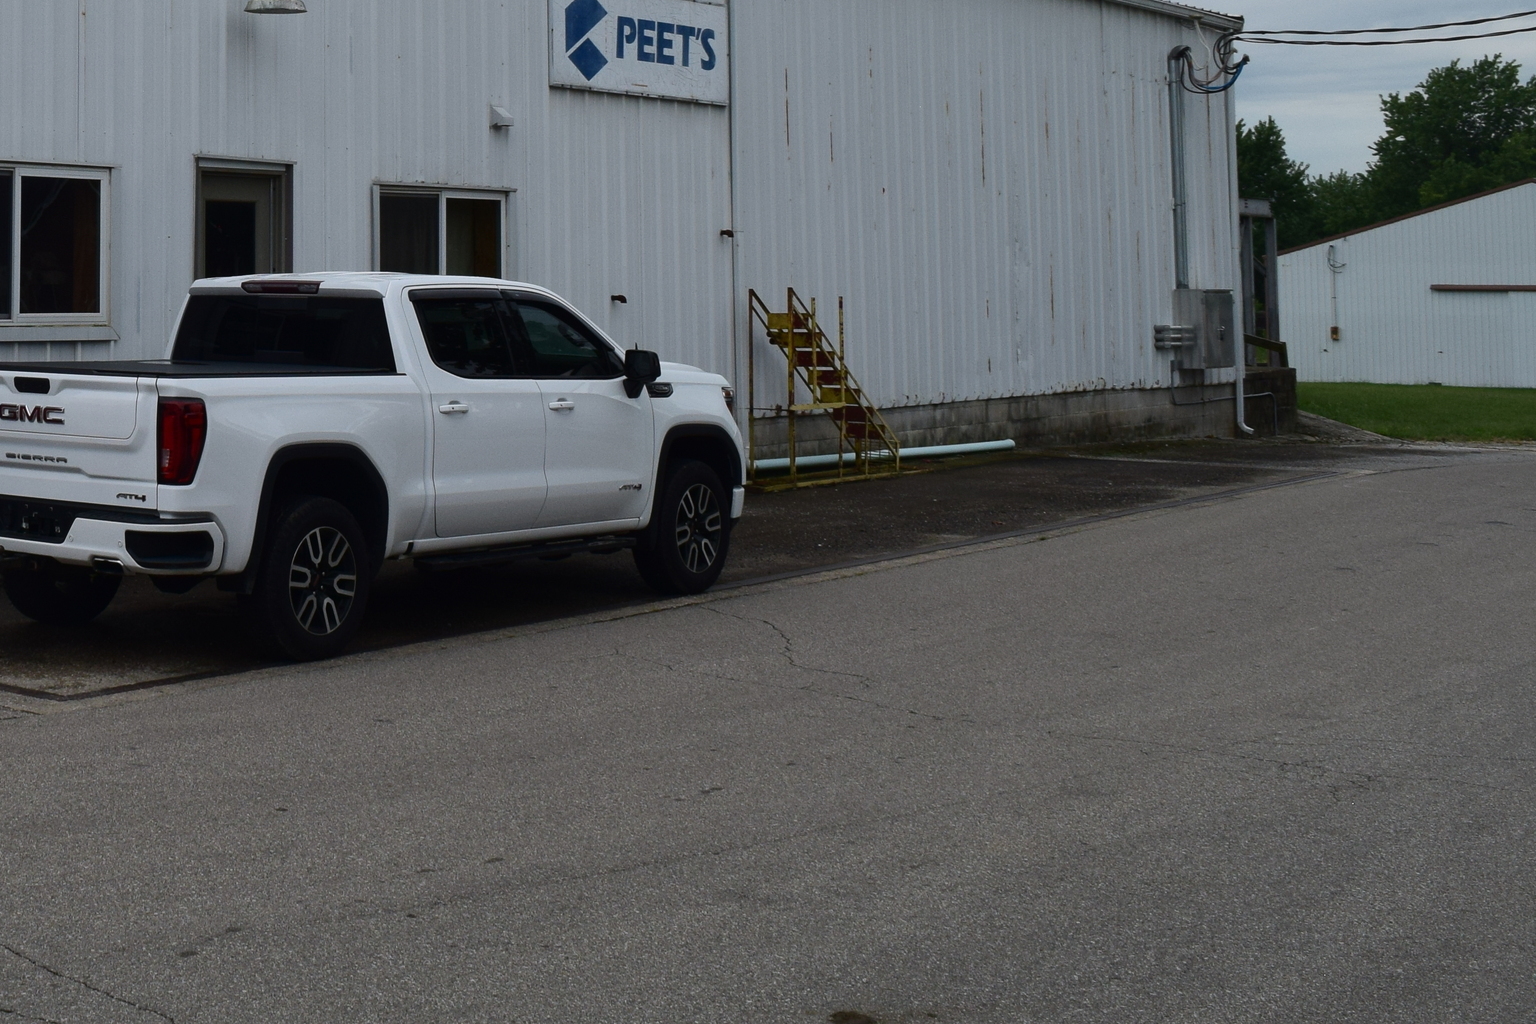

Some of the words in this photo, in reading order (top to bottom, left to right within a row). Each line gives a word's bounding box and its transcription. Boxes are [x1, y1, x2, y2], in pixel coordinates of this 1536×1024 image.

[616, 15, 716, 71] PEET'S
[5, 452, 68, 464] SIERRA
[116, 492, 147, 503] AT4
